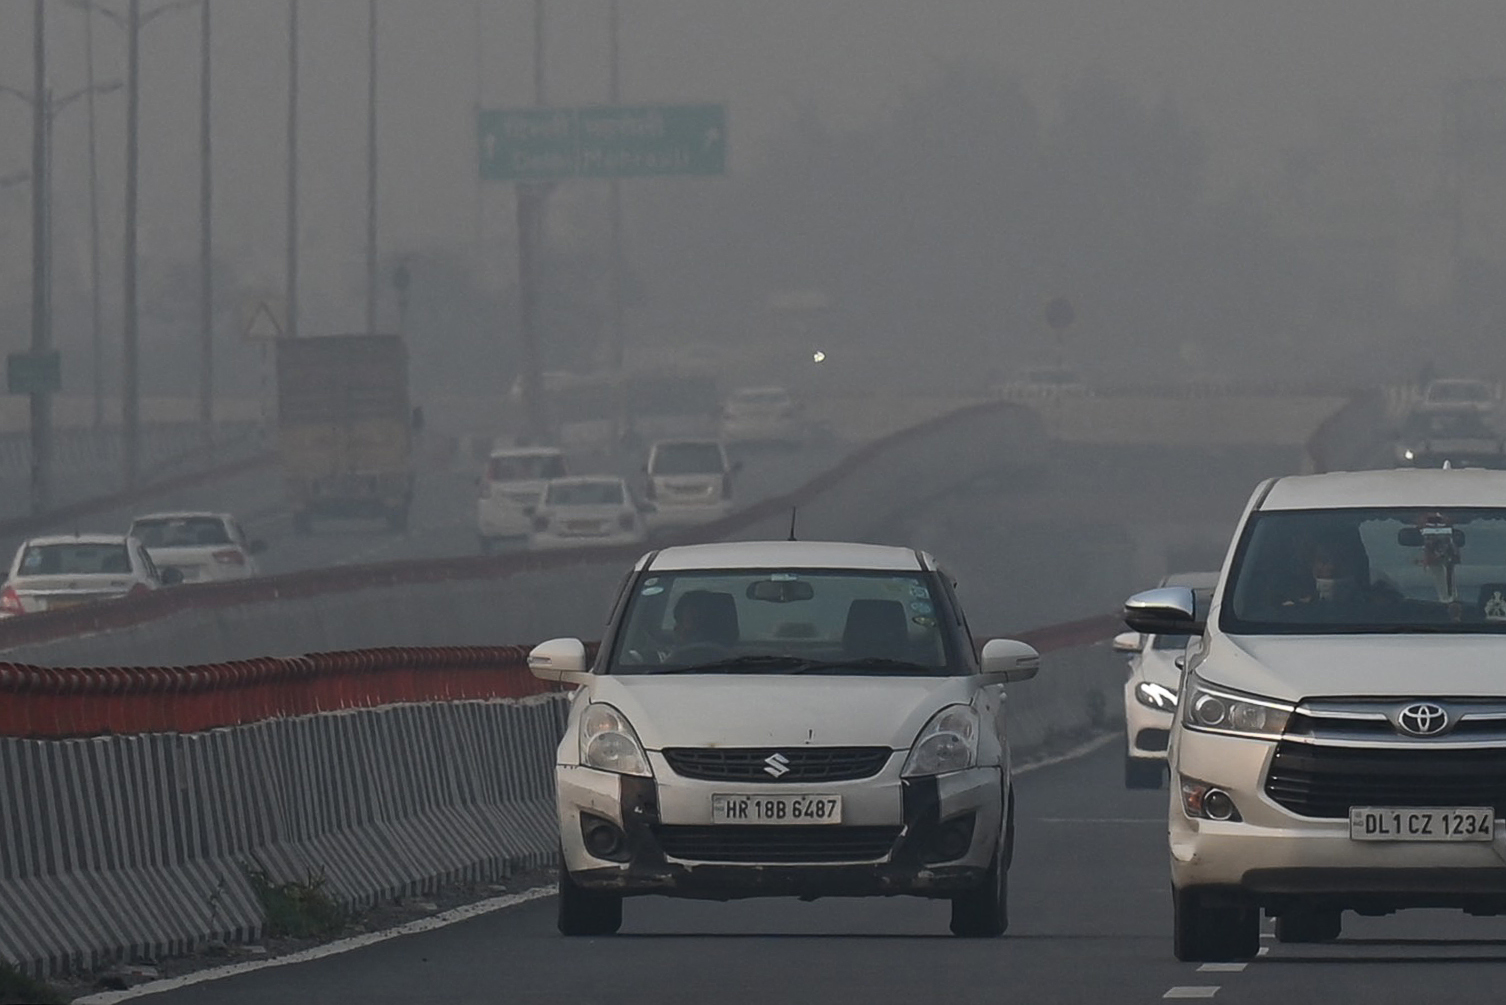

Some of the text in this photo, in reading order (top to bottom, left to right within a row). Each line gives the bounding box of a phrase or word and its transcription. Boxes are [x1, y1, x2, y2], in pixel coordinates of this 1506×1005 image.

[727, 800, 837, 819] HR 18B 6487
[1409, 814, 1433, 834] CZ
[1443, 814, 1490, 834] 1234
